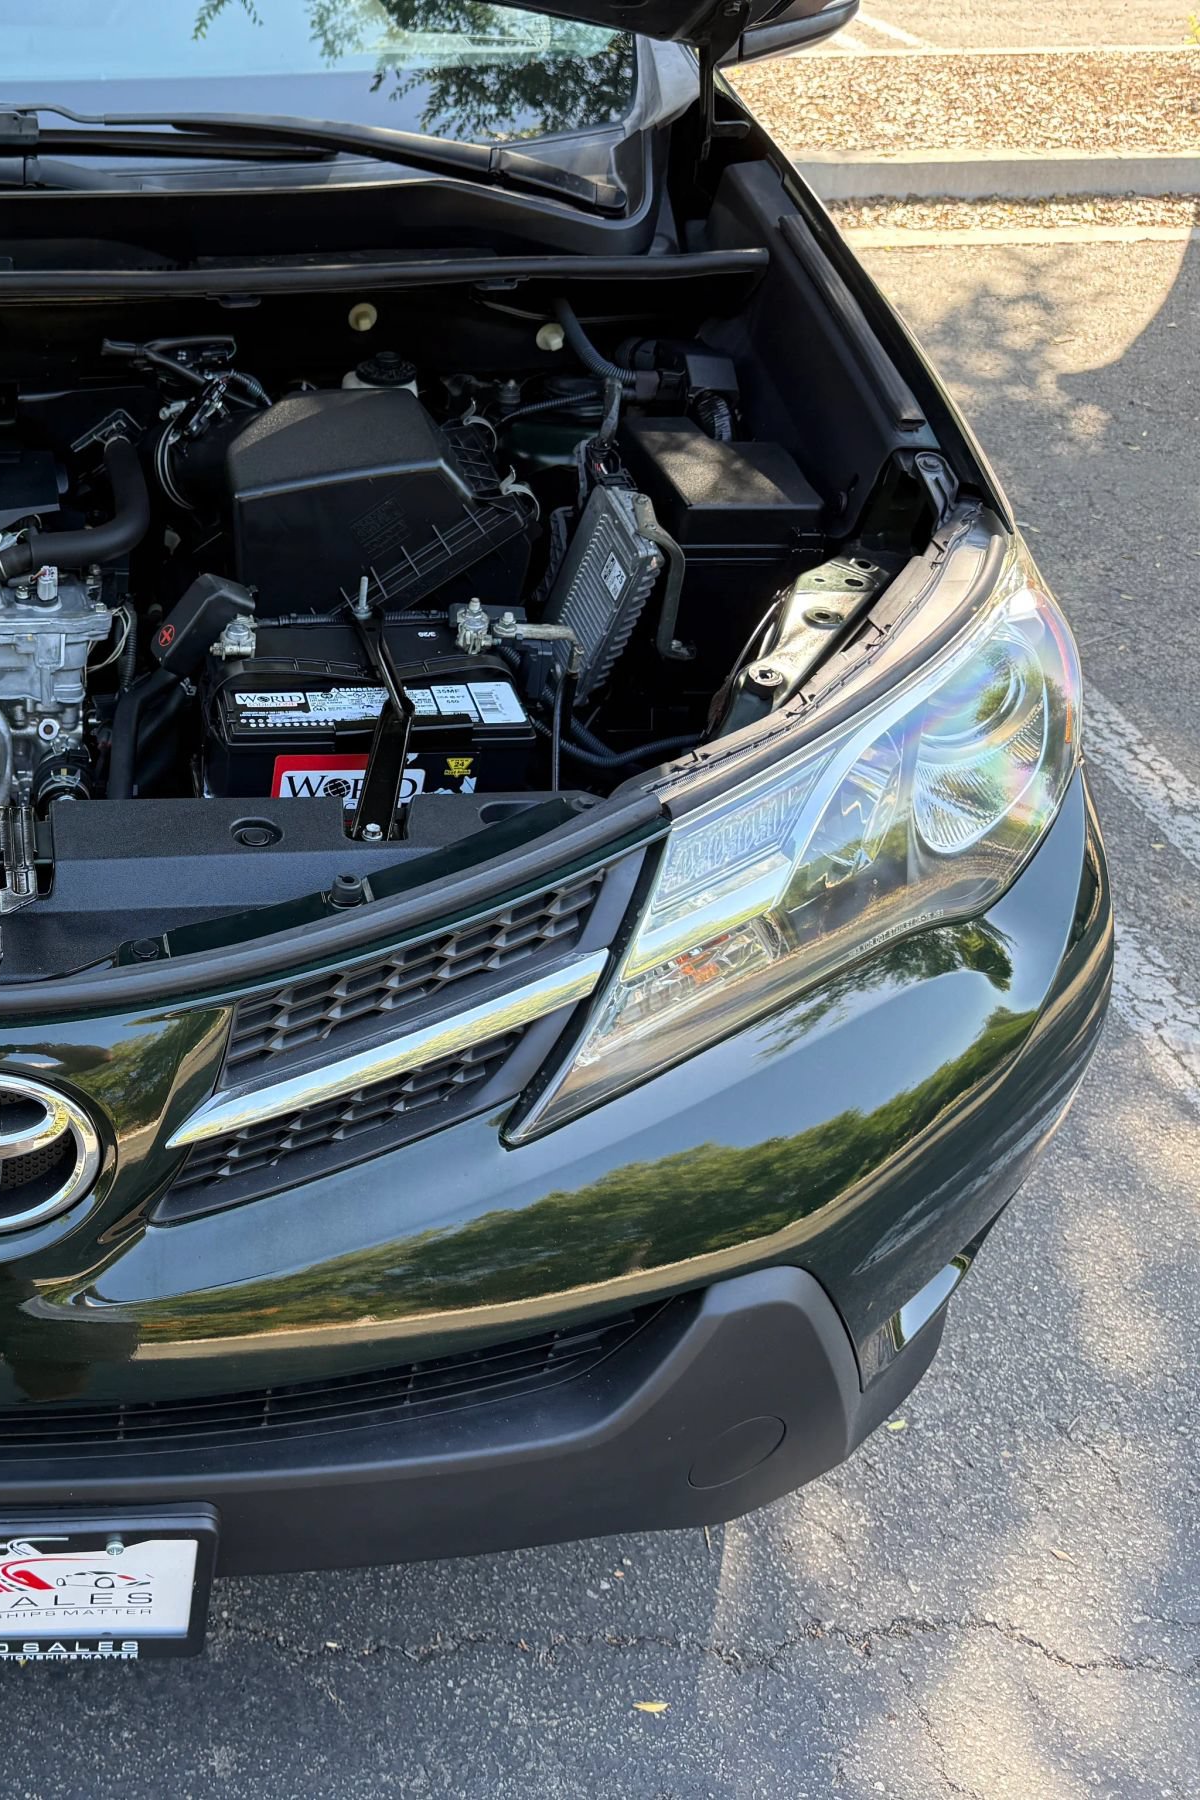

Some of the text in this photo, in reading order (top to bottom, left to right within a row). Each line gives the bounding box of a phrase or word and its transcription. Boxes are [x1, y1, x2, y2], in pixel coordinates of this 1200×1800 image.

[238, 695, 302, 703] WORLD
[63, 1608, 152, 1616] MATTER
[22, 1640, 138, 1653] SALES
